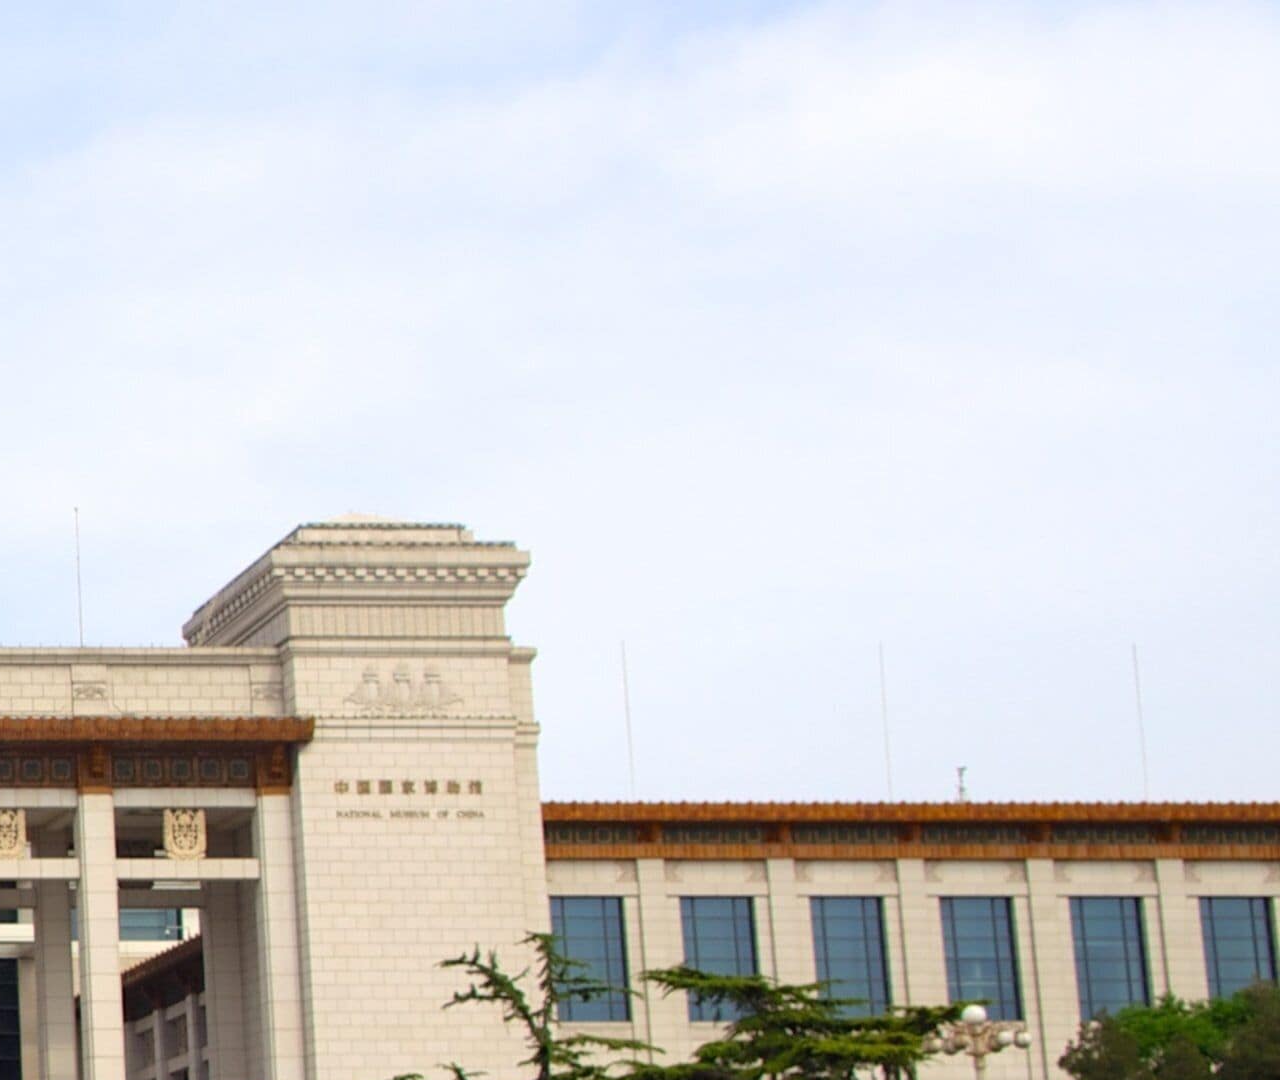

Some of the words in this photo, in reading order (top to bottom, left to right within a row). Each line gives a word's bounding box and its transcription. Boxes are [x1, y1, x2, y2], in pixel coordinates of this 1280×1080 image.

[336, 809, 382, 818] NATIONAL
[389, 809, 430, 818] MUSEUM
[437, 809, 449, 818] OF
[456, 809, 484, 818] CHINA
